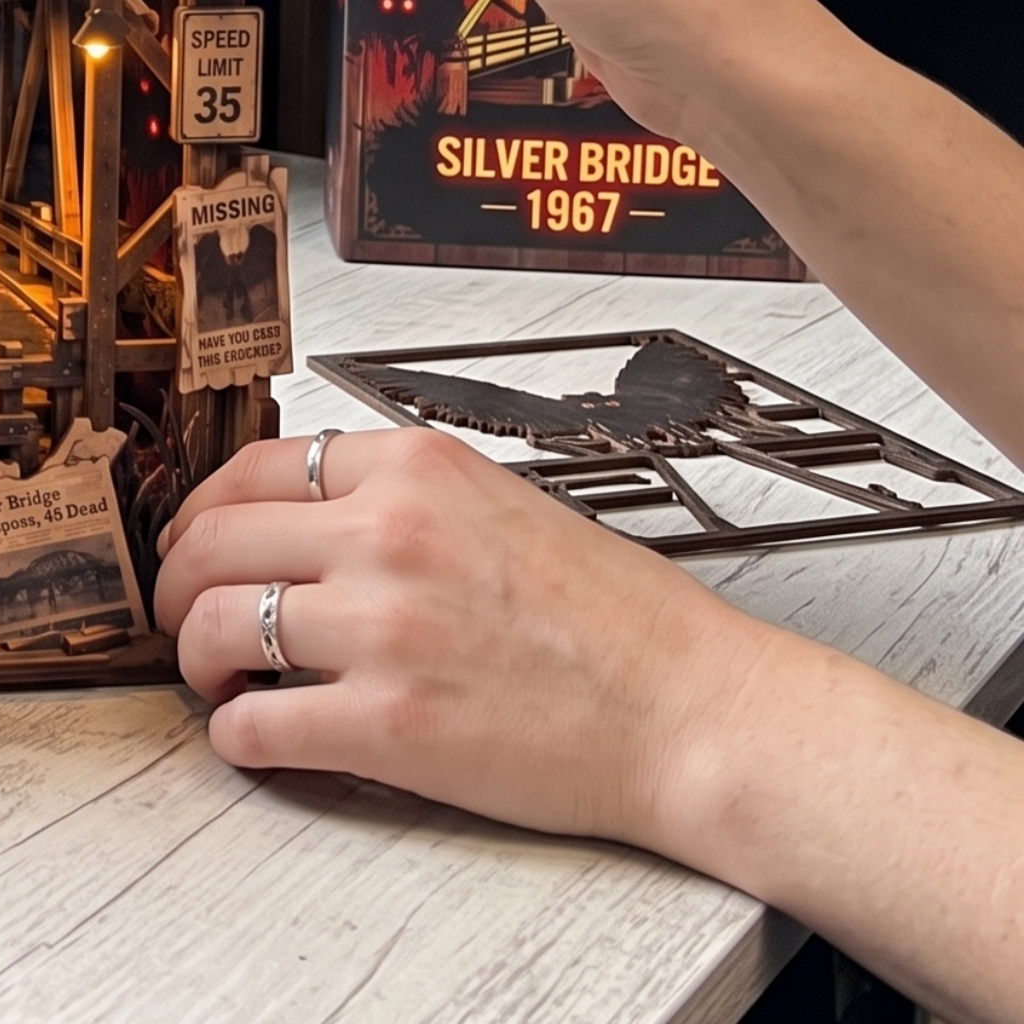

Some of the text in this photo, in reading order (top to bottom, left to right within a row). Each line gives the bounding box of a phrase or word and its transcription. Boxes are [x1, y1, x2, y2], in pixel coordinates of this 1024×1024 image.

[191, 30, 251, 49] SPEED
[198, 58, 244, 77] LIMIT
[194, 86, 242, 124] 35
[436, 135, 720, 188] SILVER BRIDGE
[192, 193, 275, 226] MISSING
[526, 189, 621, 233] 1967
[228, 330, 250, 345] YOU
[198, 353, 222, 368] THIS
[5, 489, 61, 511] Bridge
[44, 508, 64, 524] 45
[66, 497, 109, 519] Dead
